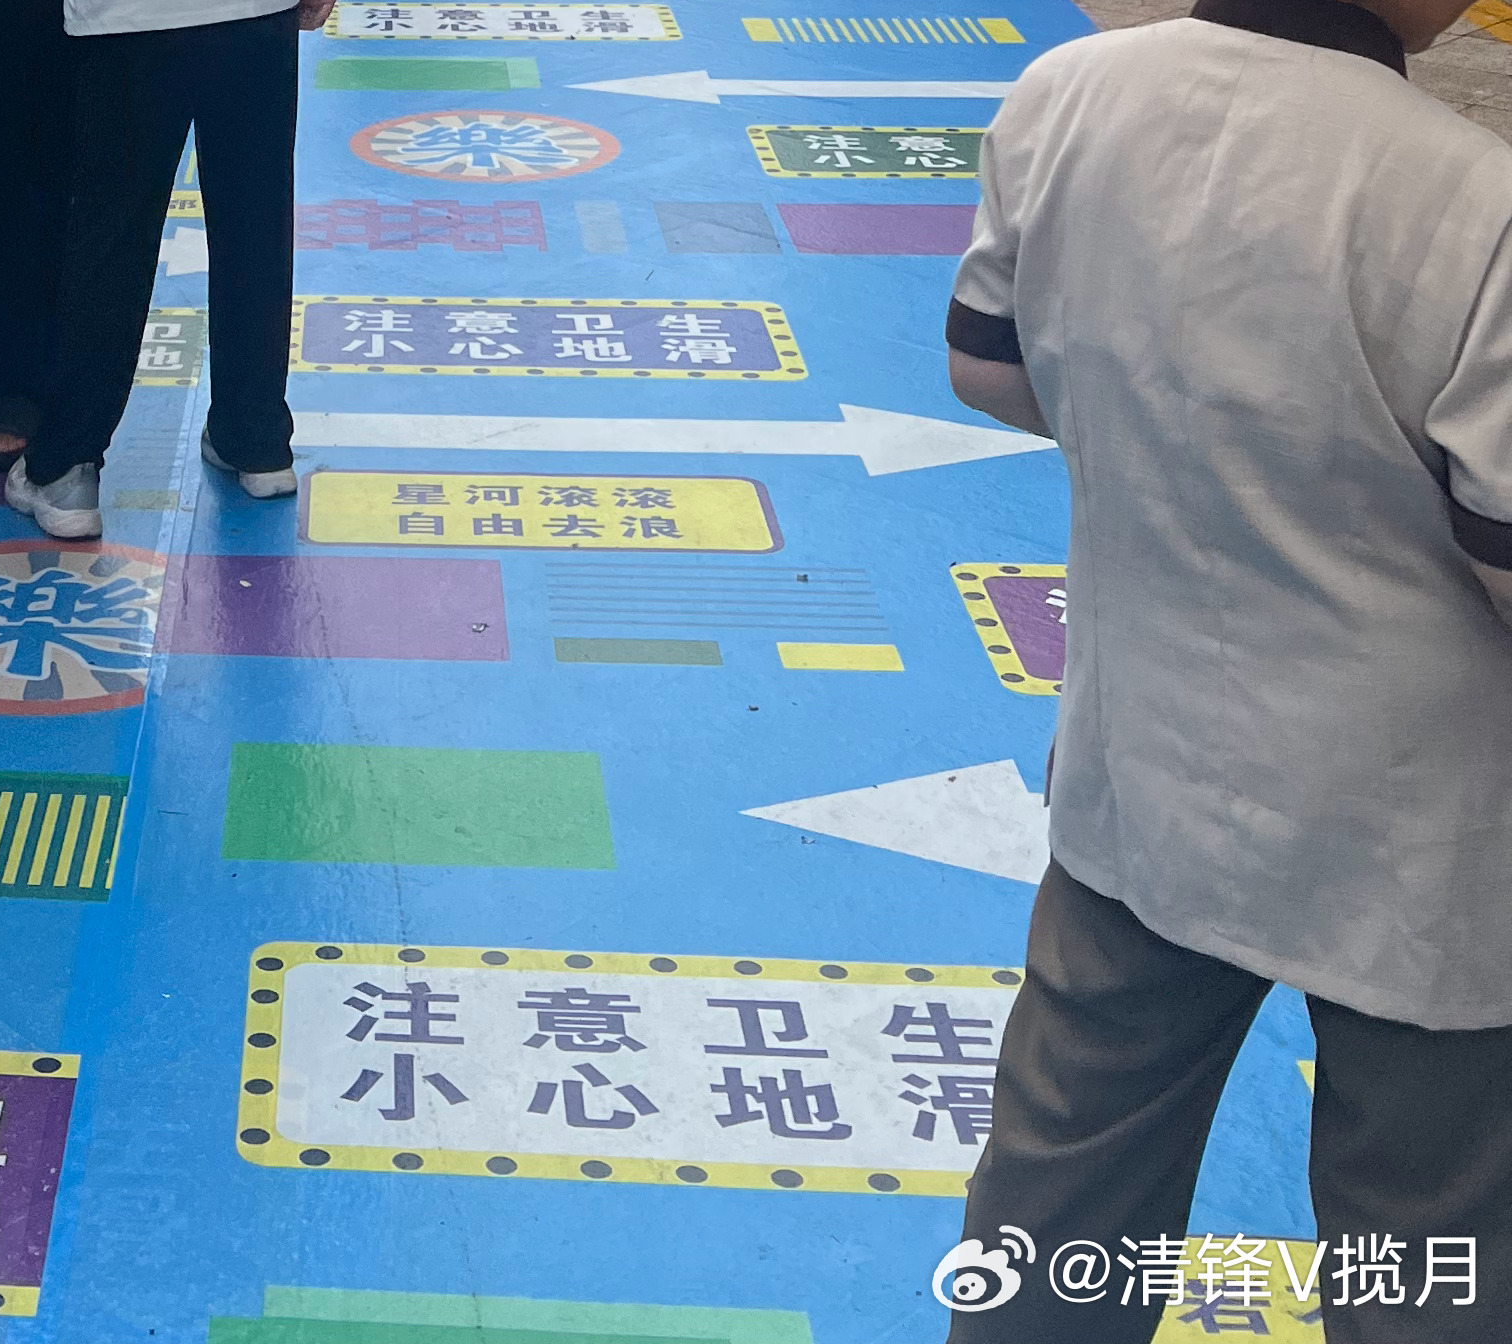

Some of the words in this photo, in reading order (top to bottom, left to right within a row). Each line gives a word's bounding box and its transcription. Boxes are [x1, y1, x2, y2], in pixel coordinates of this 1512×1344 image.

[366, 8, 630, 22] 注意卫生
[366, 20, 634, 34] 小心地滑
[804, 134, 956, 152] 注意
[814, 151, 967, 170] 小心
[343, 309, 731, 338] 注意卫生
[342, 333, 737, 365] 小心地滑
[392, 482, 677, 510] 星河滚滚
[398, 512, 685, 538] 自由去浪
[342, 981, 1002, 1067] 注意卫生
[339, 1052, 994, 1146] 小心地滑
